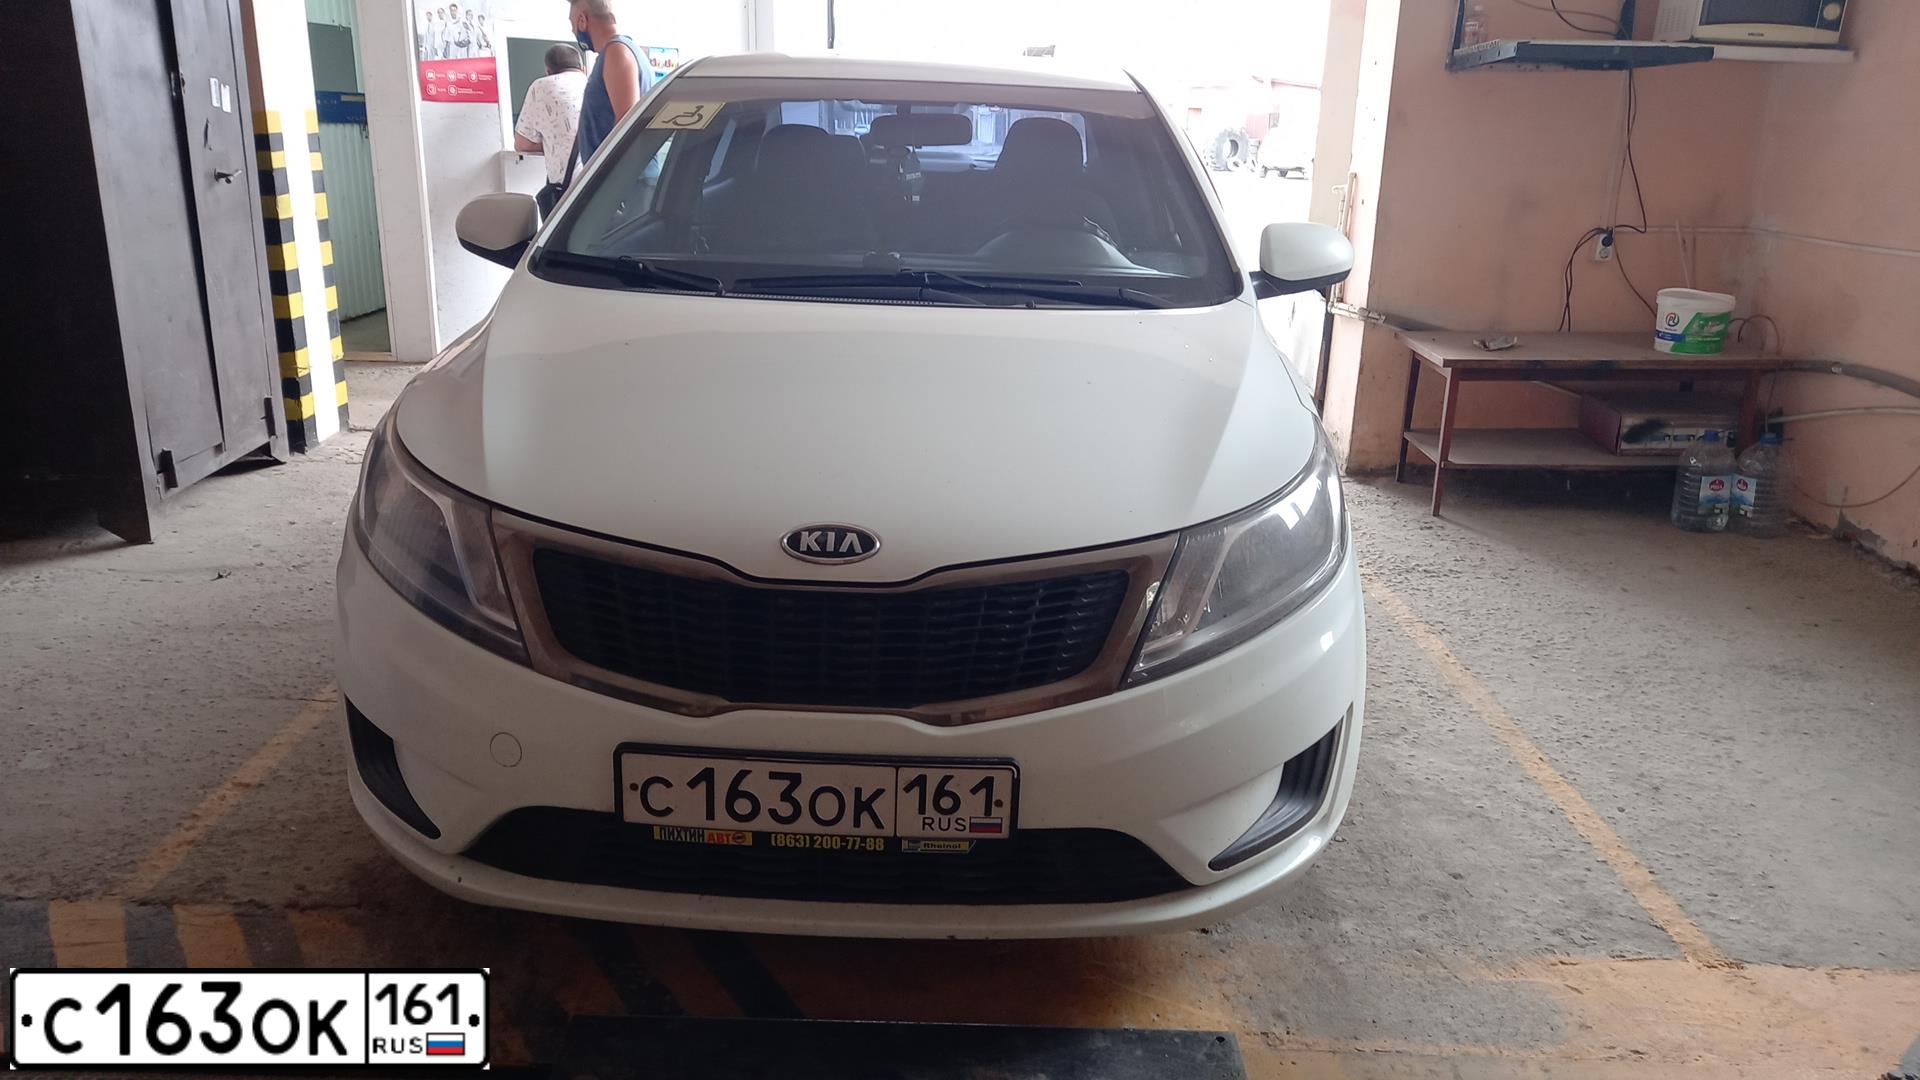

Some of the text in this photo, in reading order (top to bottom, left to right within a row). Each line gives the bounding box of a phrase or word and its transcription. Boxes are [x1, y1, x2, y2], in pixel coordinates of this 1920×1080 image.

[800, 531, 863, 553] KIA
[902, 774, 997, 816] 161
[922, 817, 967, 832] RUS
[771, 834, 885, 851] (863) 200-77-88
